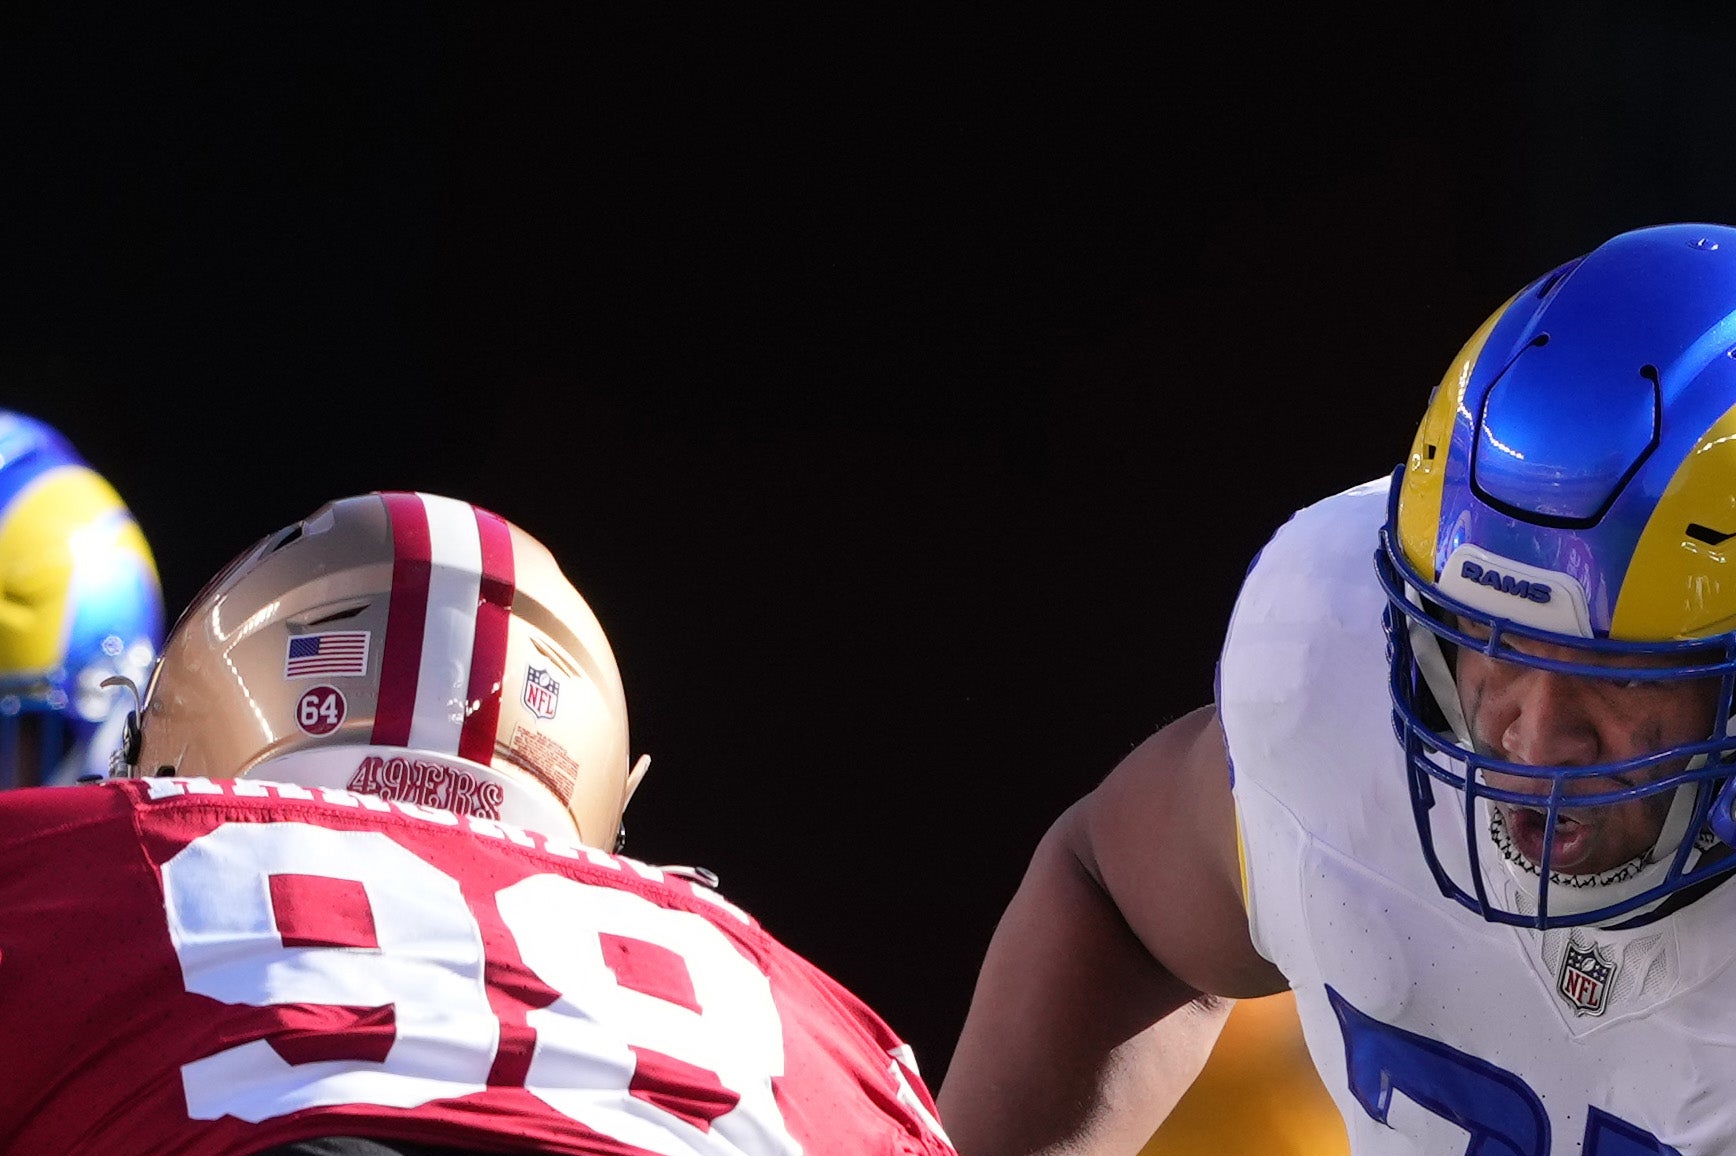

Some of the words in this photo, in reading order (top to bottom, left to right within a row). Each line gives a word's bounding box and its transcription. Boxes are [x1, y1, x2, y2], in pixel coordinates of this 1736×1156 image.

[1461, 560, 1552, 604] RAMS
[301, 693, 338, 725] 64
[527, 683, 554, 715] NFL
[347, 756, 503, 821] 49ERS
[1564, 969, 1599, 1007] NFL
